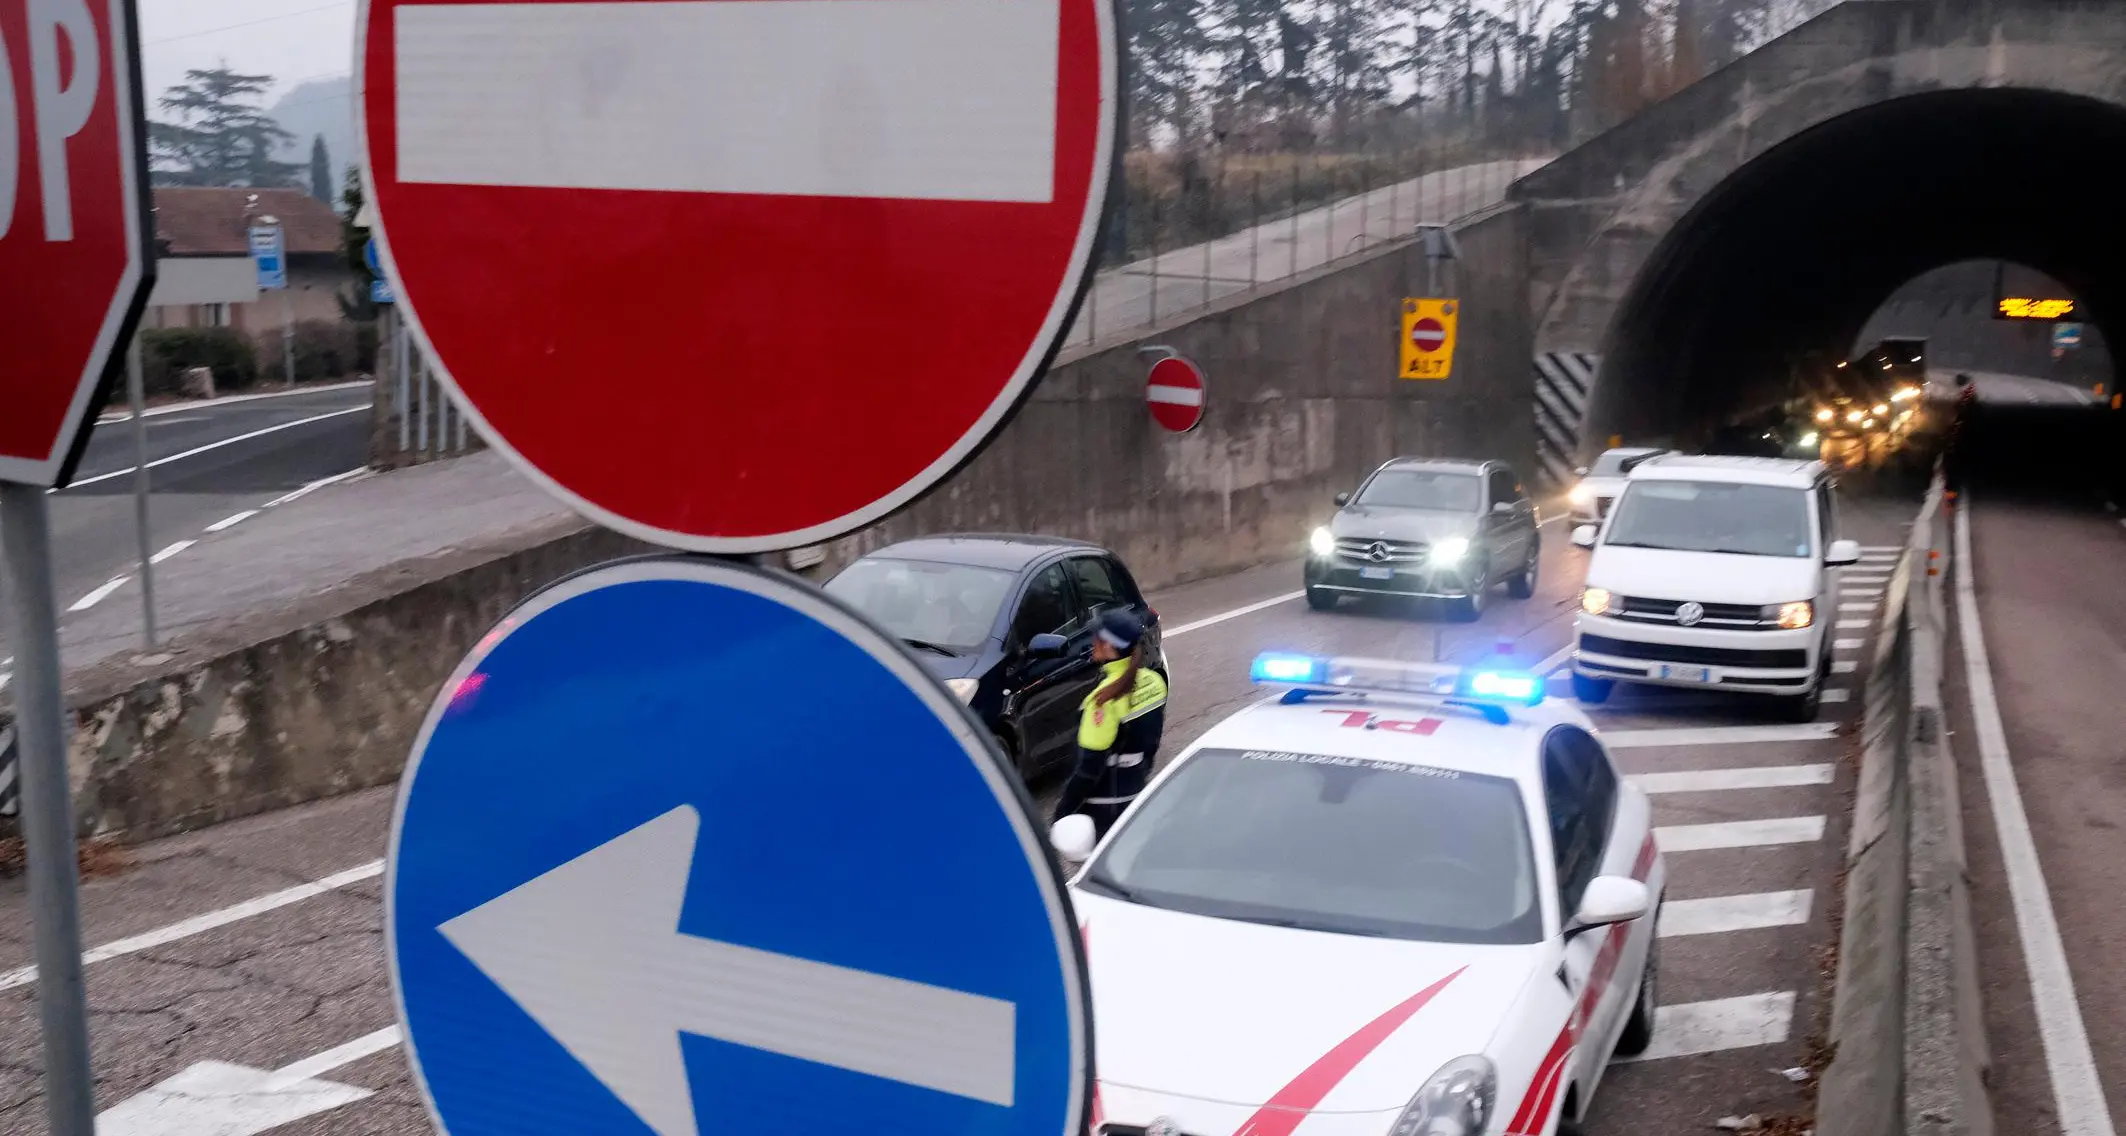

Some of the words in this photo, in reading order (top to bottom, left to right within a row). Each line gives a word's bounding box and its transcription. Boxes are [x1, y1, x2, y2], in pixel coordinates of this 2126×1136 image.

[0, 0, 100, 242] P
[1407, 358, 1444, 373] ALT
[1321, 709, 1443, 736] PL
[1241, 750, 1298, 761] POLIZIA
[1299, 754, 1360, 767] LOCALE
